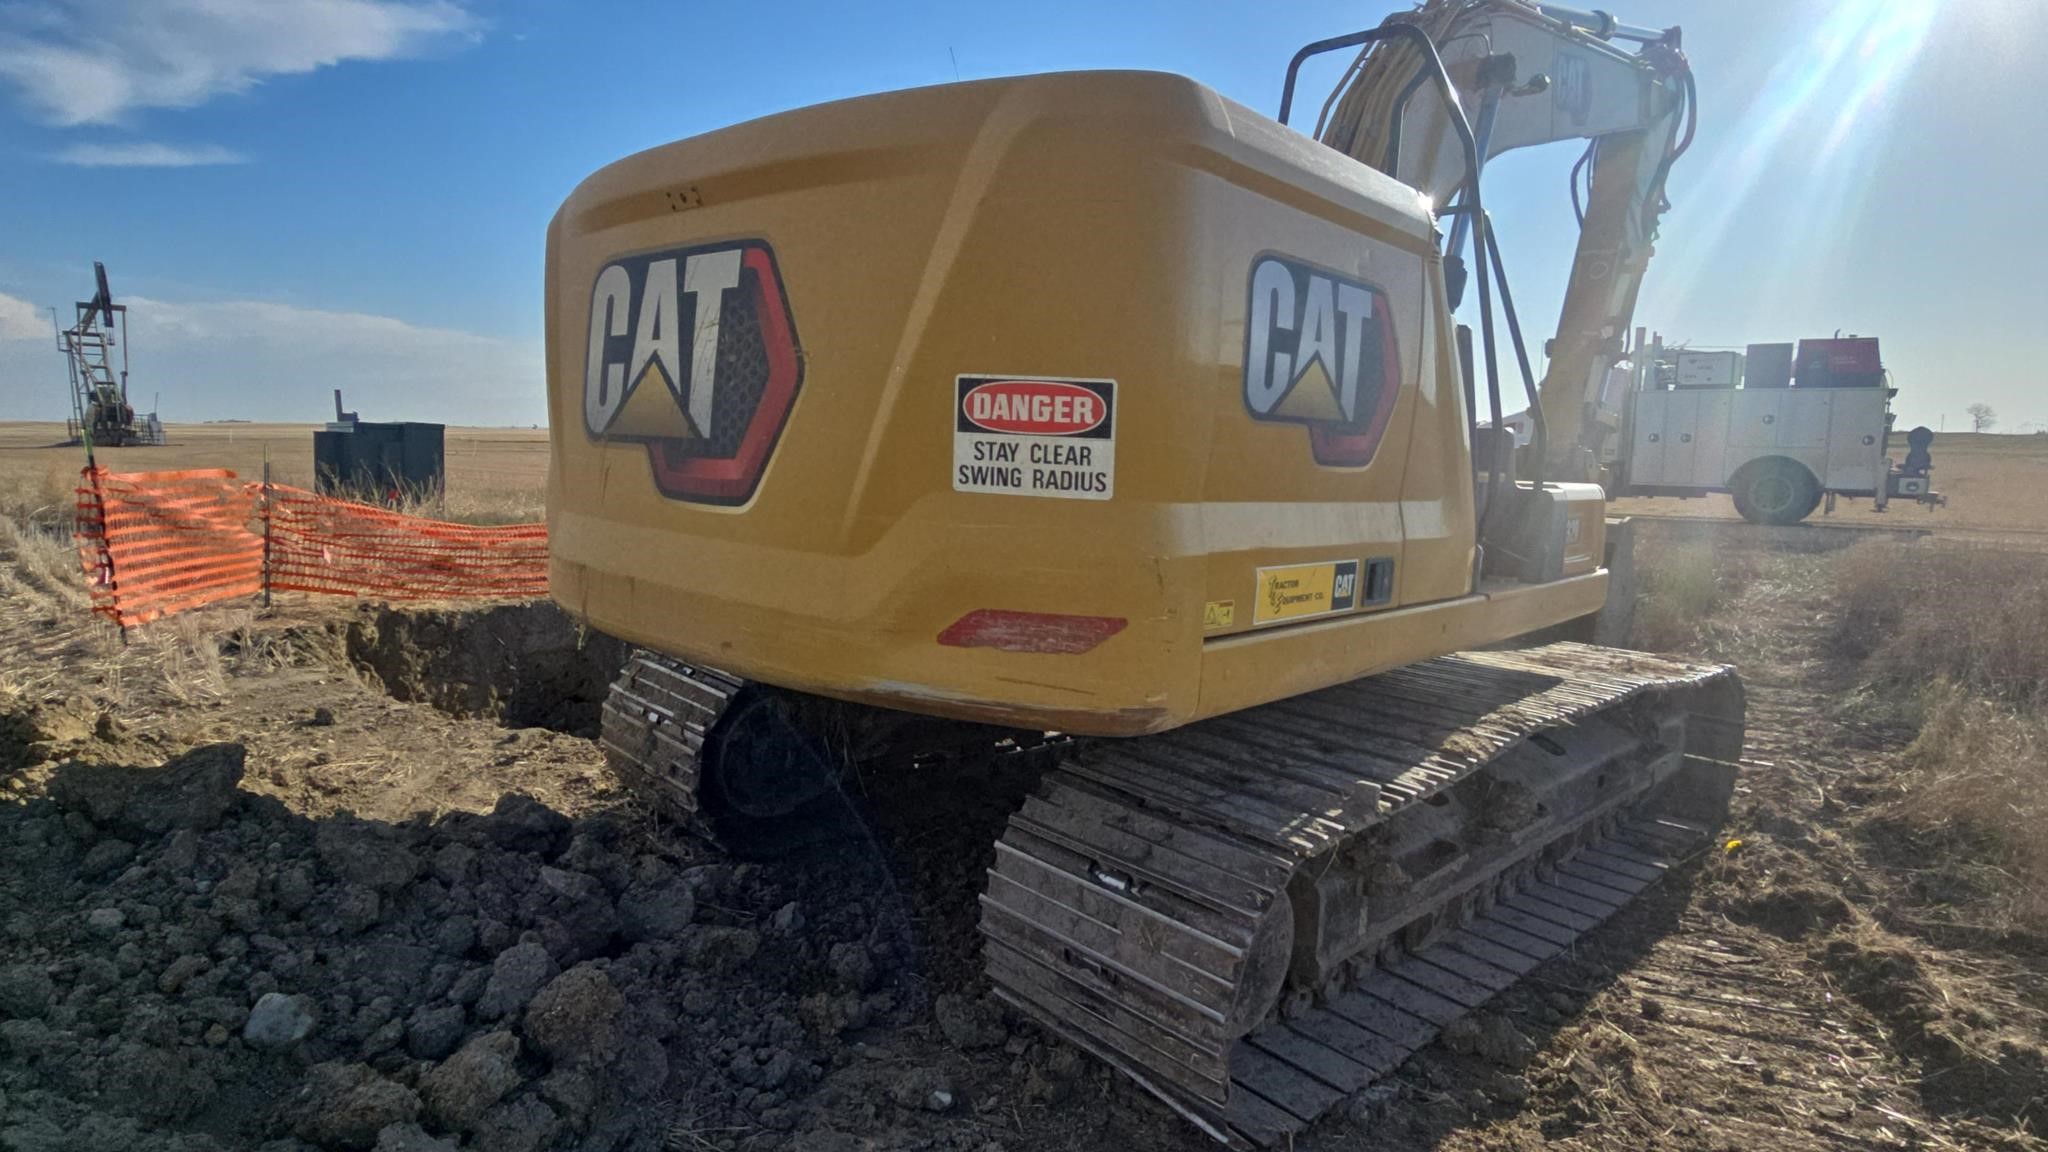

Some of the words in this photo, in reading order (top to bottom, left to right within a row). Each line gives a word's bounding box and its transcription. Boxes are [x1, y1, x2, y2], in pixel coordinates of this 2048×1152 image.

[586, 249, 742, 439] CAT
[1247, 260, 1372, 422] CAT
[973, 393, 1094, 424] DANGER
[974, 441, 1019, 462] STAY
[1030, 443, 1092, 466] CLEAR
[958, 465, 1022, 488] SWING
[1032, 469, 1107, 493] RADIUS
[1334, 574, 1354, 598] CAT
